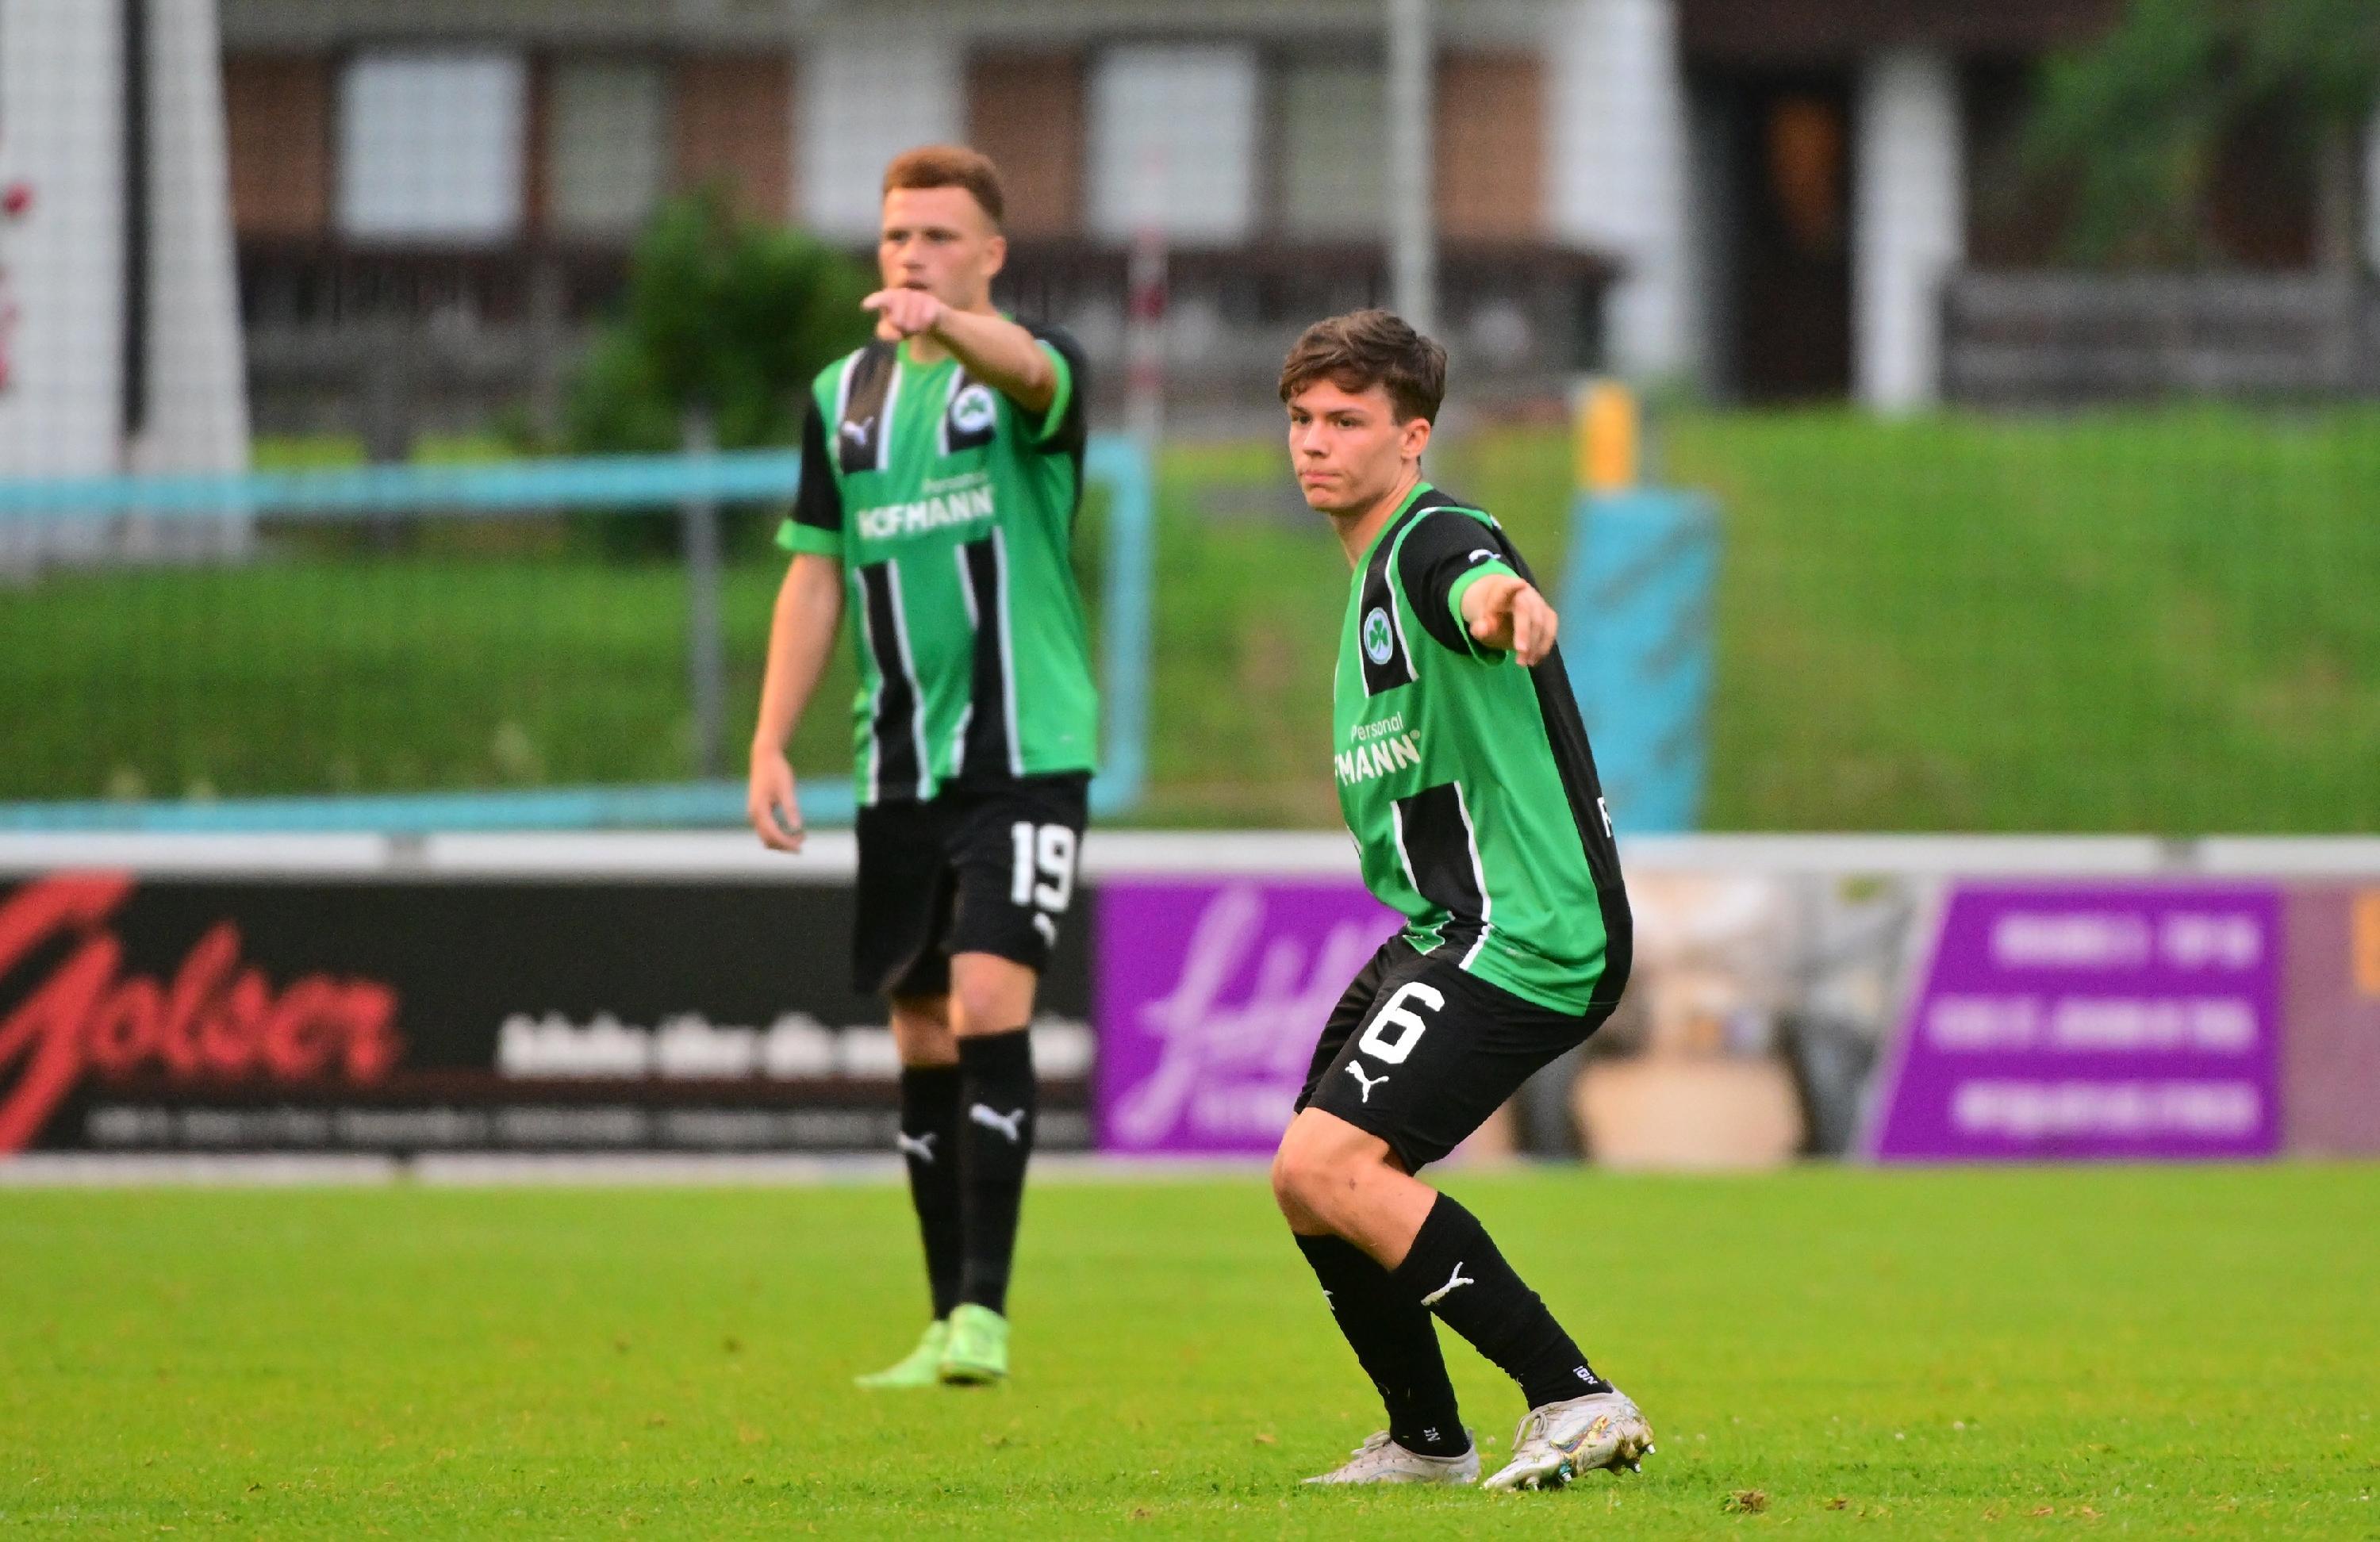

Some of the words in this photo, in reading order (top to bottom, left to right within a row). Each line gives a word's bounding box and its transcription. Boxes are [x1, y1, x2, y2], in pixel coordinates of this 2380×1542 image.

[1350, 711, 1404, 743] Personal
[1011, 820, 1077, 913] 19
[1358, 981, 1445, 1064] 6
